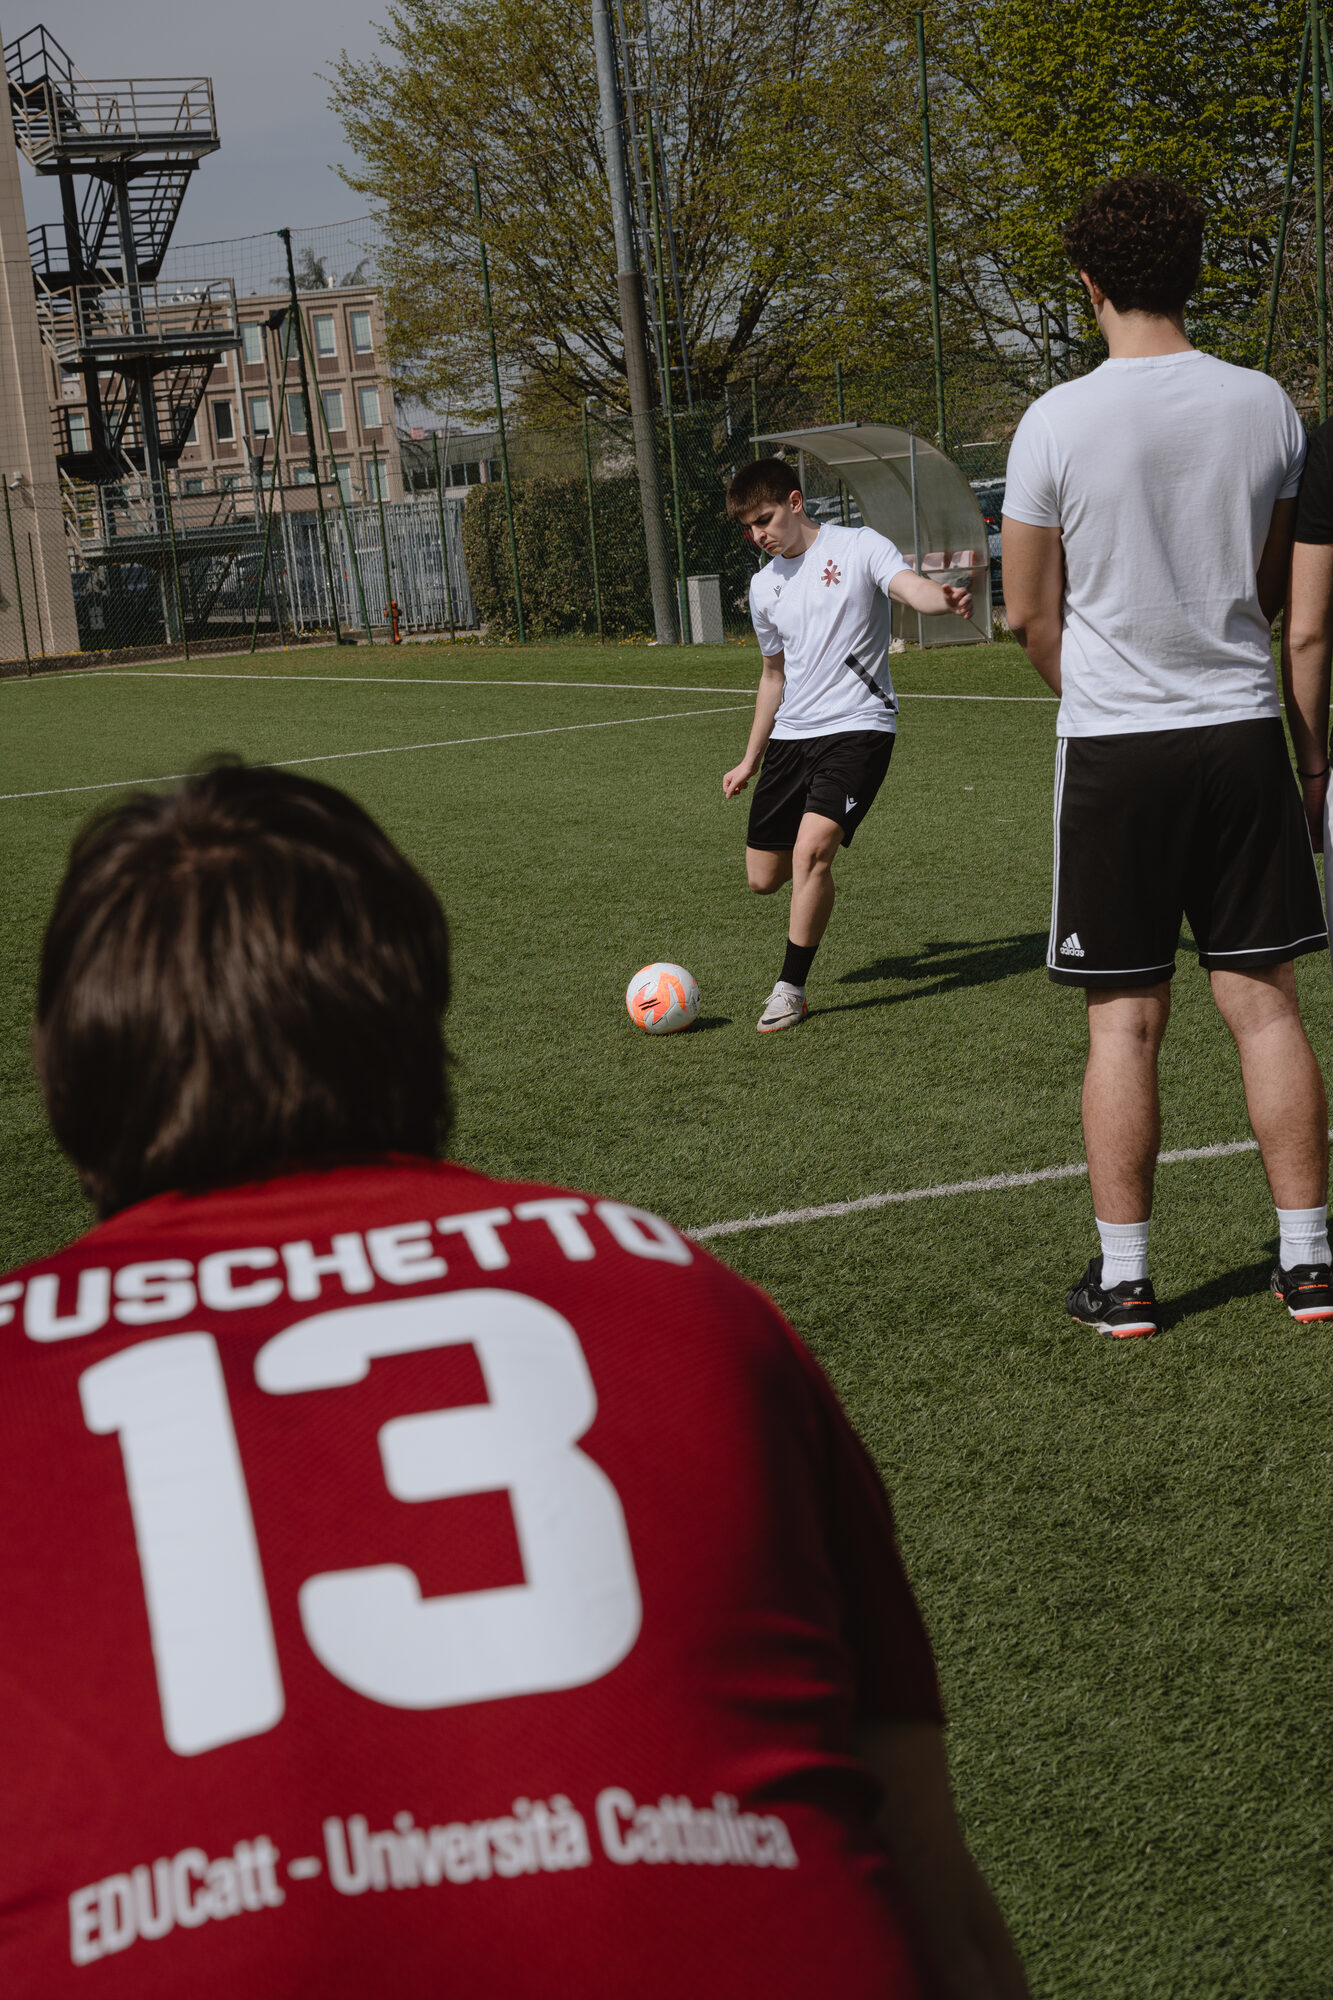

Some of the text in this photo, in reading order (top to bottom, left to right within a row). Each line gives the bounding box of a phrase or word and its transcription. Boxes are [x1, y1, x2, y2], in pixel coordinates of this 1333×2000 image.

[1060, 946, 1085, 957] adidas
[78, 1287, 643, 1757] 13
[68, 1786, 798, 1966] EDUCatt - Università Cattolica
